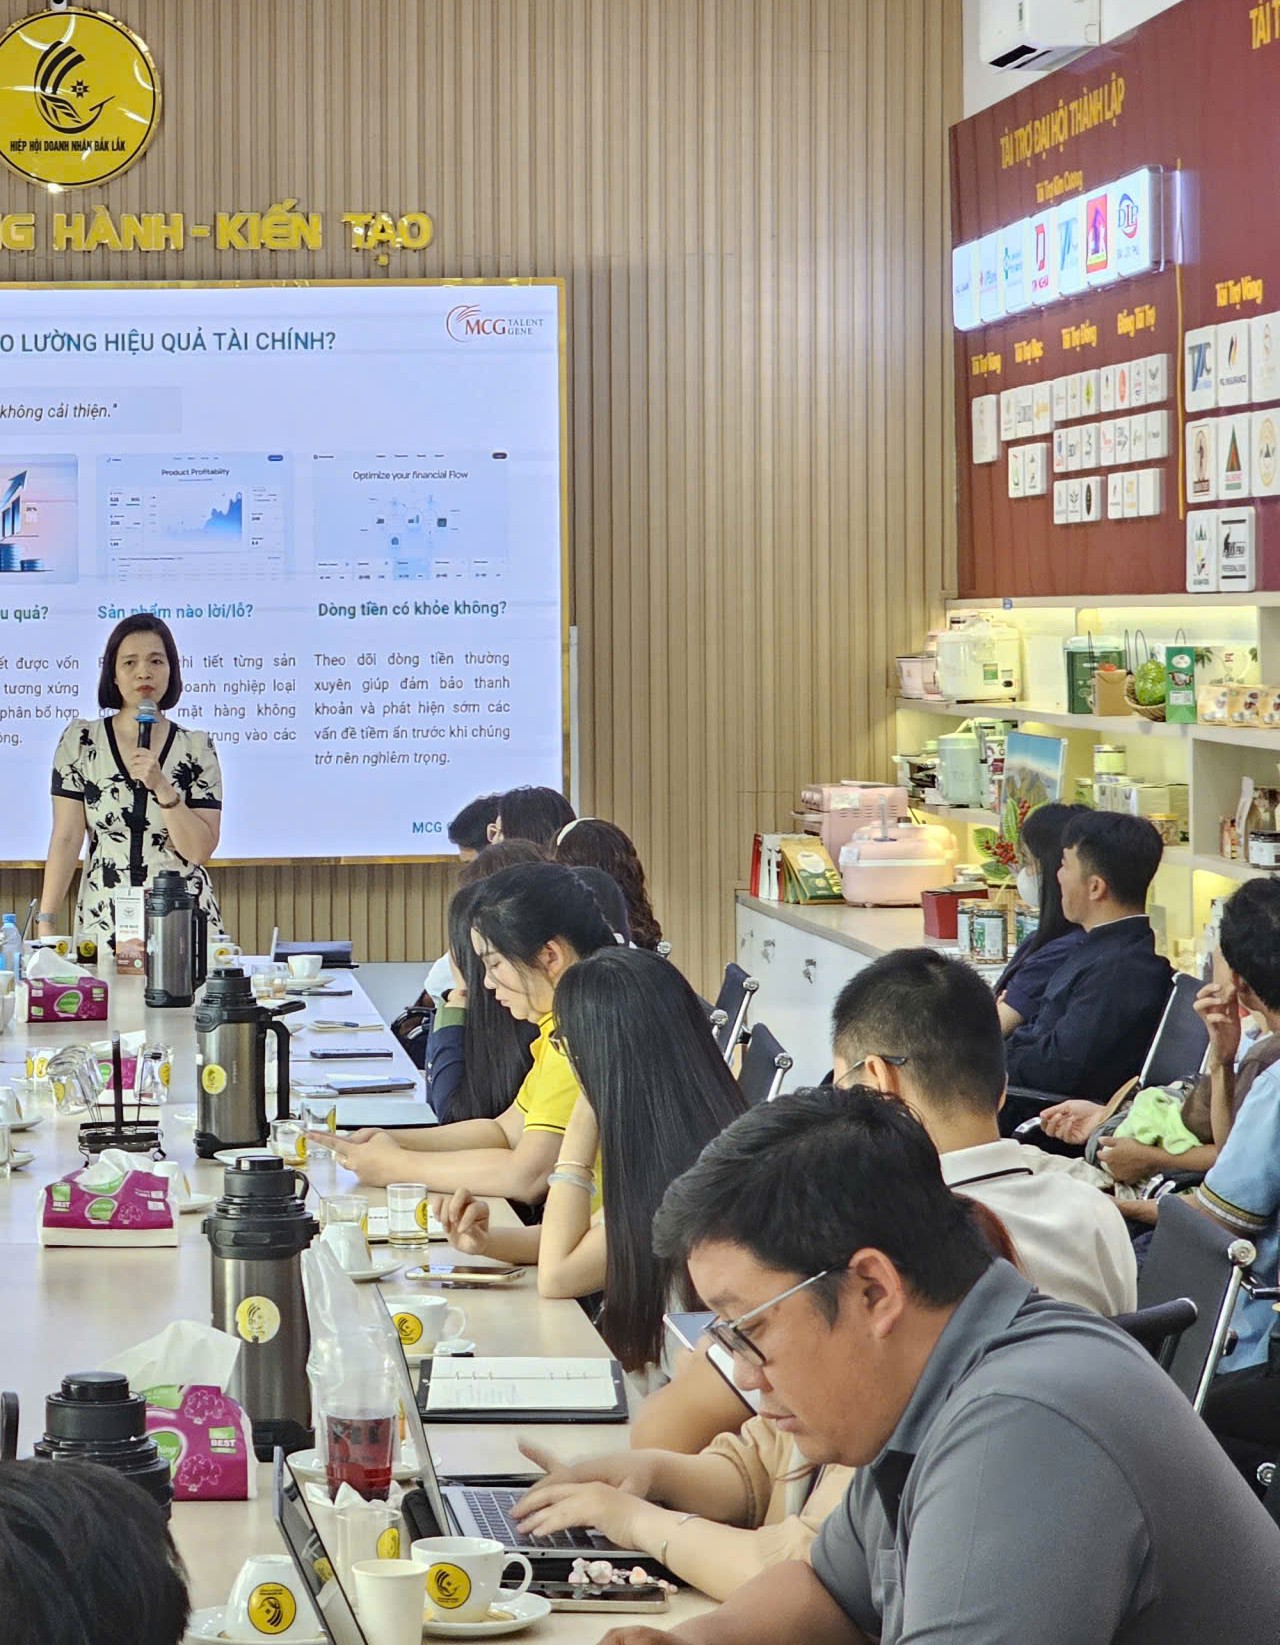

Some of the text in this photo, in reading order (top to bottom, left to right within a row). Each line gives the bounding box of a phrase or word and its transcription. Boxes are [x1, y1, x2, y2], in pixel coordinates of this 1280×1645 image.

[53, 208, 185, 252] HÀNH
[217, 197, 322, 251] KIẾN
[342, 209, 434, 265] TẠO
[465, 318, 544, 335] MCG TALENT
[22, 329, 96, 352] LƯỜNG
[105, 329, 154, 356] HIỆU
[162, 326, 207, 353] QUẢ
[213, 327, 248, 351] TÀI
[256, 327, 335, 350] CHÍNH?
[0, 404, 43, 422] không
[48, 402, 69, 418] cải
[73, 403, 117, 420] thiện."
[14, 604, 48, 623] quả?
[98, 603, 125, 619] Sản
[175, 604, 203, 618] nào
[208, 604, 254, 619] lời/lỗ?
[318, 600, 506, 620] Dòng tiền có khỏe không?
[16, 657, 48, 671] được
[56, 655, 79, 669] vốn
[314, 651, 509, 668] Theo dõi dòng tiền thường
[4, 683, 41, 696] tương
[47, 681, 78, 696] xứng
[314, 676, 510, 694] xuyên giúp đảm bảo thanh
[412, 822, 442, 833] MCG
[210, 1439, 237, 1447] BEST
